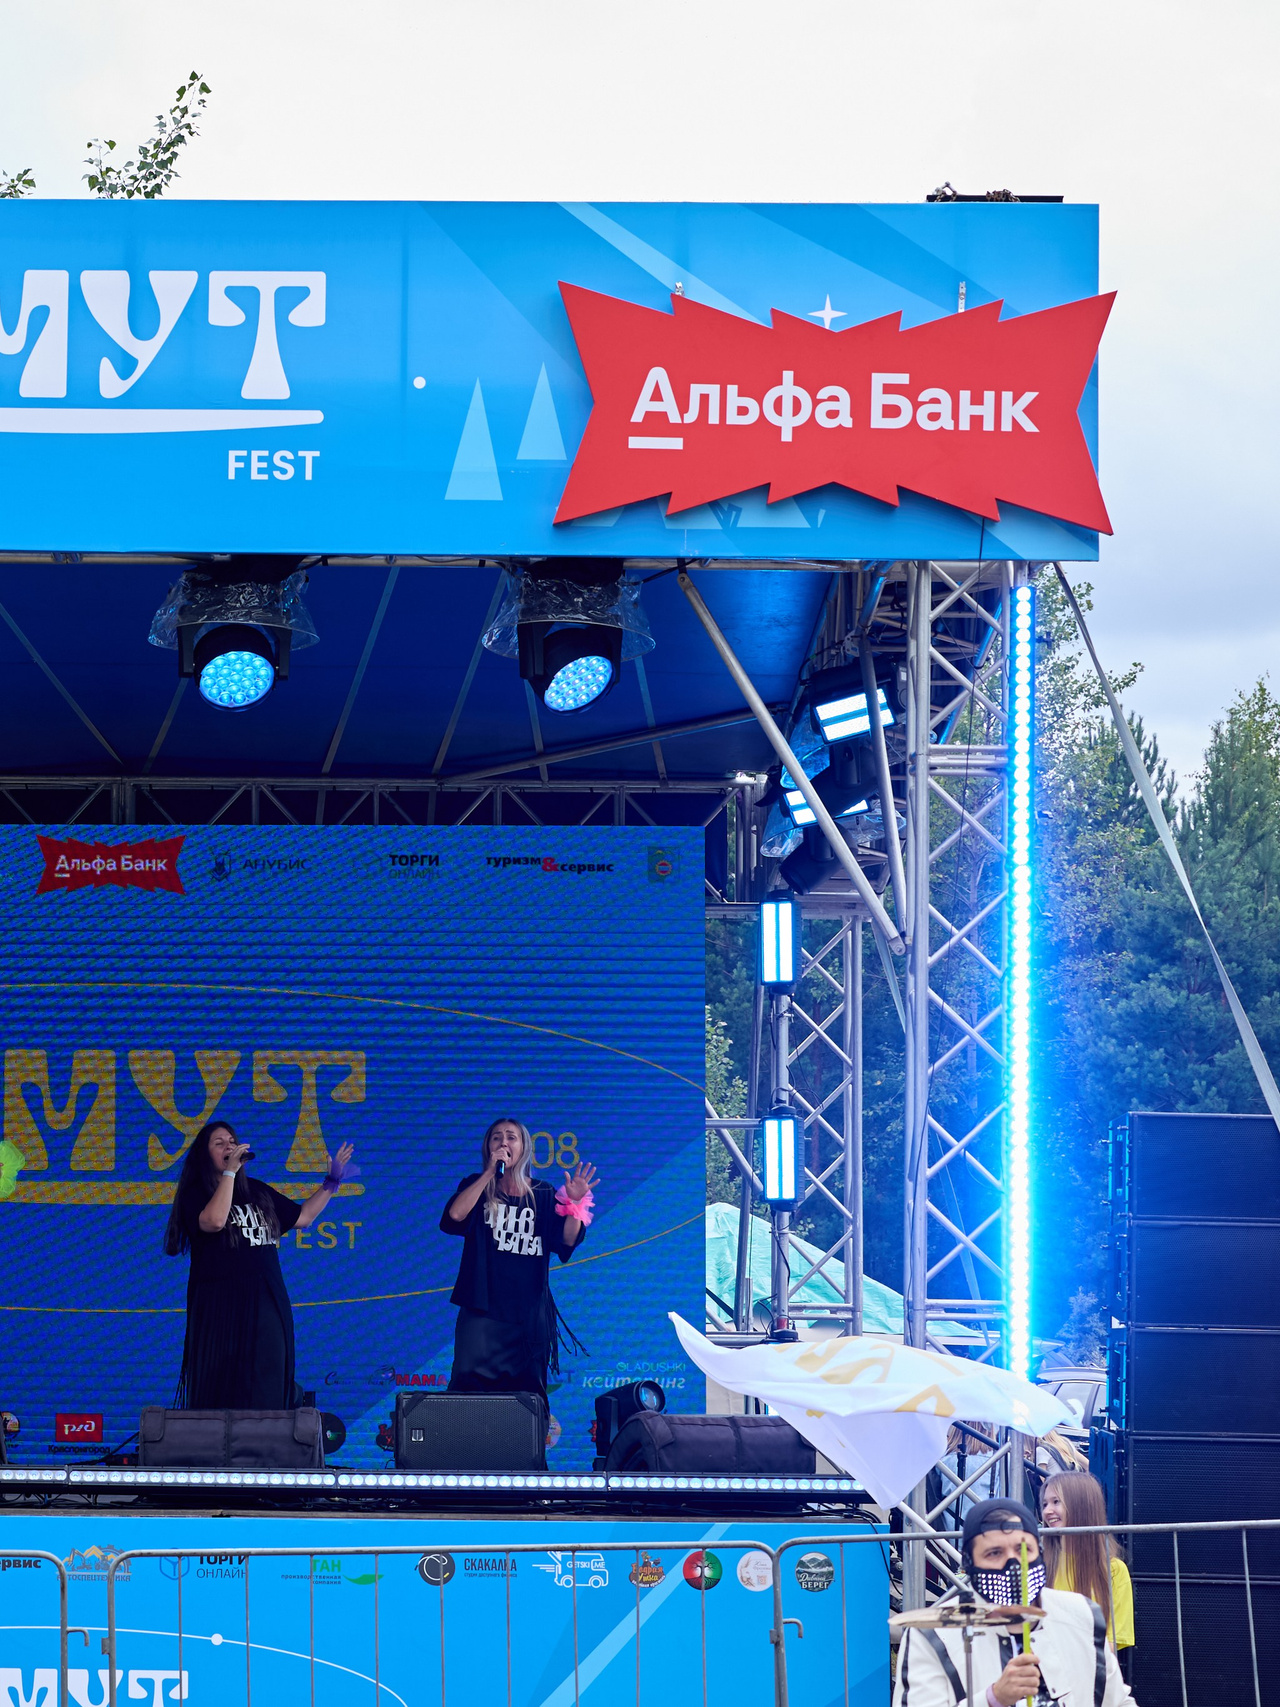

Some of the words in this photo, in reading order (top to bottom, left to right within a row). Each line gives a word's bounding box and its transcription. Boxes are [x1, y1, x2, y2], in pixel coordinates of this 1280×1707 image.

[629, 366, 853, 445] Альфа
[870, 372, 1040, 433] Банк
[228, 450, 320, 480] FEST
[55, 855, 117, 875] Альфа
[121, 855, 167, 871] Банк
[242, 858, 311, 870] АНУБИС
[389, 854, 439, 866] ТОРГИ
[57, 1574, 131, 1582] АТОСПЕЦТЕИКА
